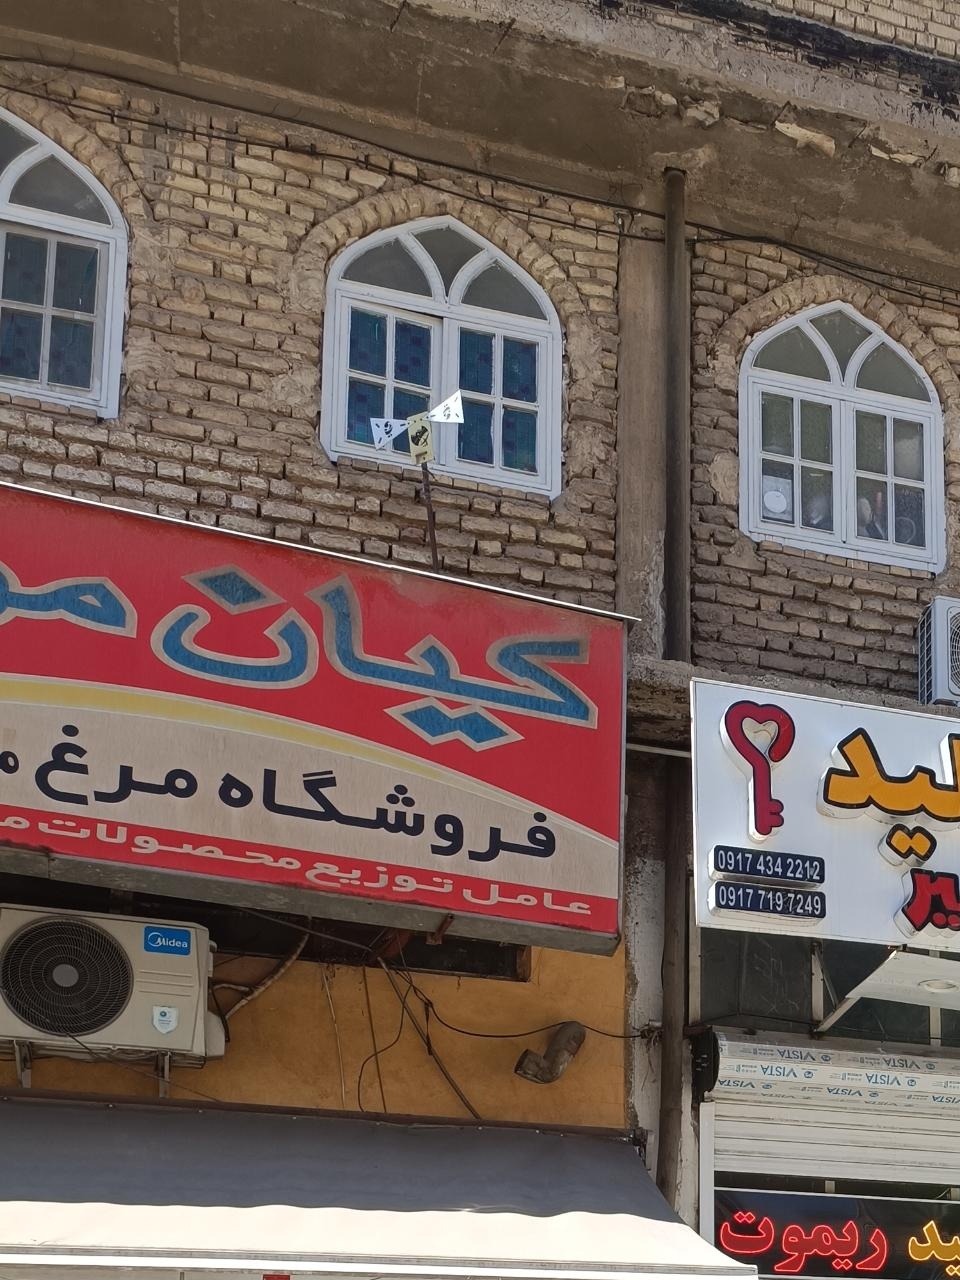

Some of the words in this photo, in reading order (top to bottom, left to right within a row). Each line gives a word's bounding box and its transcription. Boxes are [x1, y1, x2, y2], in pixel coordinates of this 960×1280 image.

[150, 563, 598, 751] کیان
[35, 725, 198, 805] مرغ
[219, 770, 556, 862] فروشگاه
[38, 819, 301, 869] محصولات
[305, 862, 453, 894] توزیع
[718, 850, 753, 872] 0917
[757, 854, 782, 876] 434
[786, 858, 820, 880] 2212
[463, 884, 592, 915] عامل
[719, 886, 753, 908] 0917
[758, 890, 783, 911] 719
[788, 893, 821, 915] 7249
[154, 937, 188, 948] Midea
[760, 1064, 797, 1079] VISTA
[864, 1072, 902, 1086] VISTA
[720, 1211, 888, 1272] ریموت
